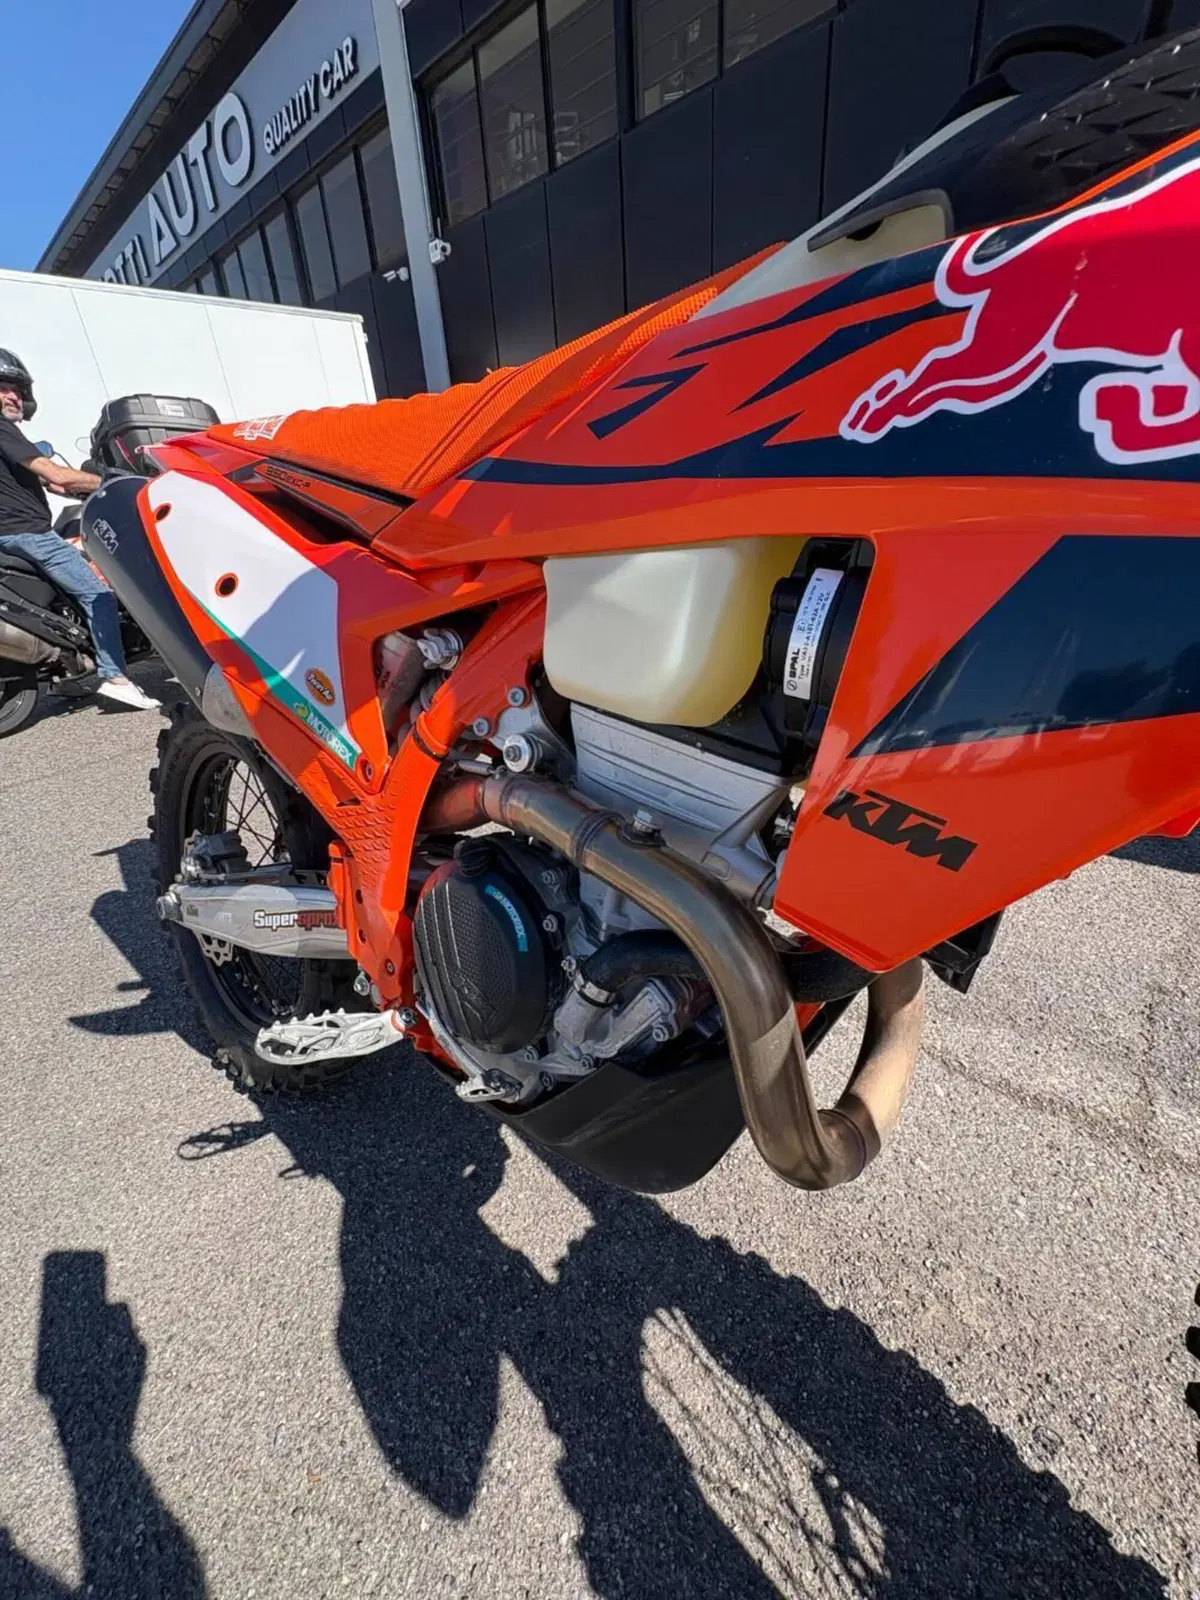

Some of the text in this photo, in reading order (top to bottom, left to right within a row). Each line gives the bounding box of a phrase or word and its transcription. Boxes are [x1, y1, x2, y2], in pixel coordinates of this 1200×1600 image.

[263, 36, 355, 154] QUALITY CAR
[148, 92, 252, 266] AUTO
[92, 518, 119, 556] KTM
[789, 648, 801, 679] SPAL
[307, 711, 353, 767] MOTOREX
[823, 789, 978, 872] KTM
